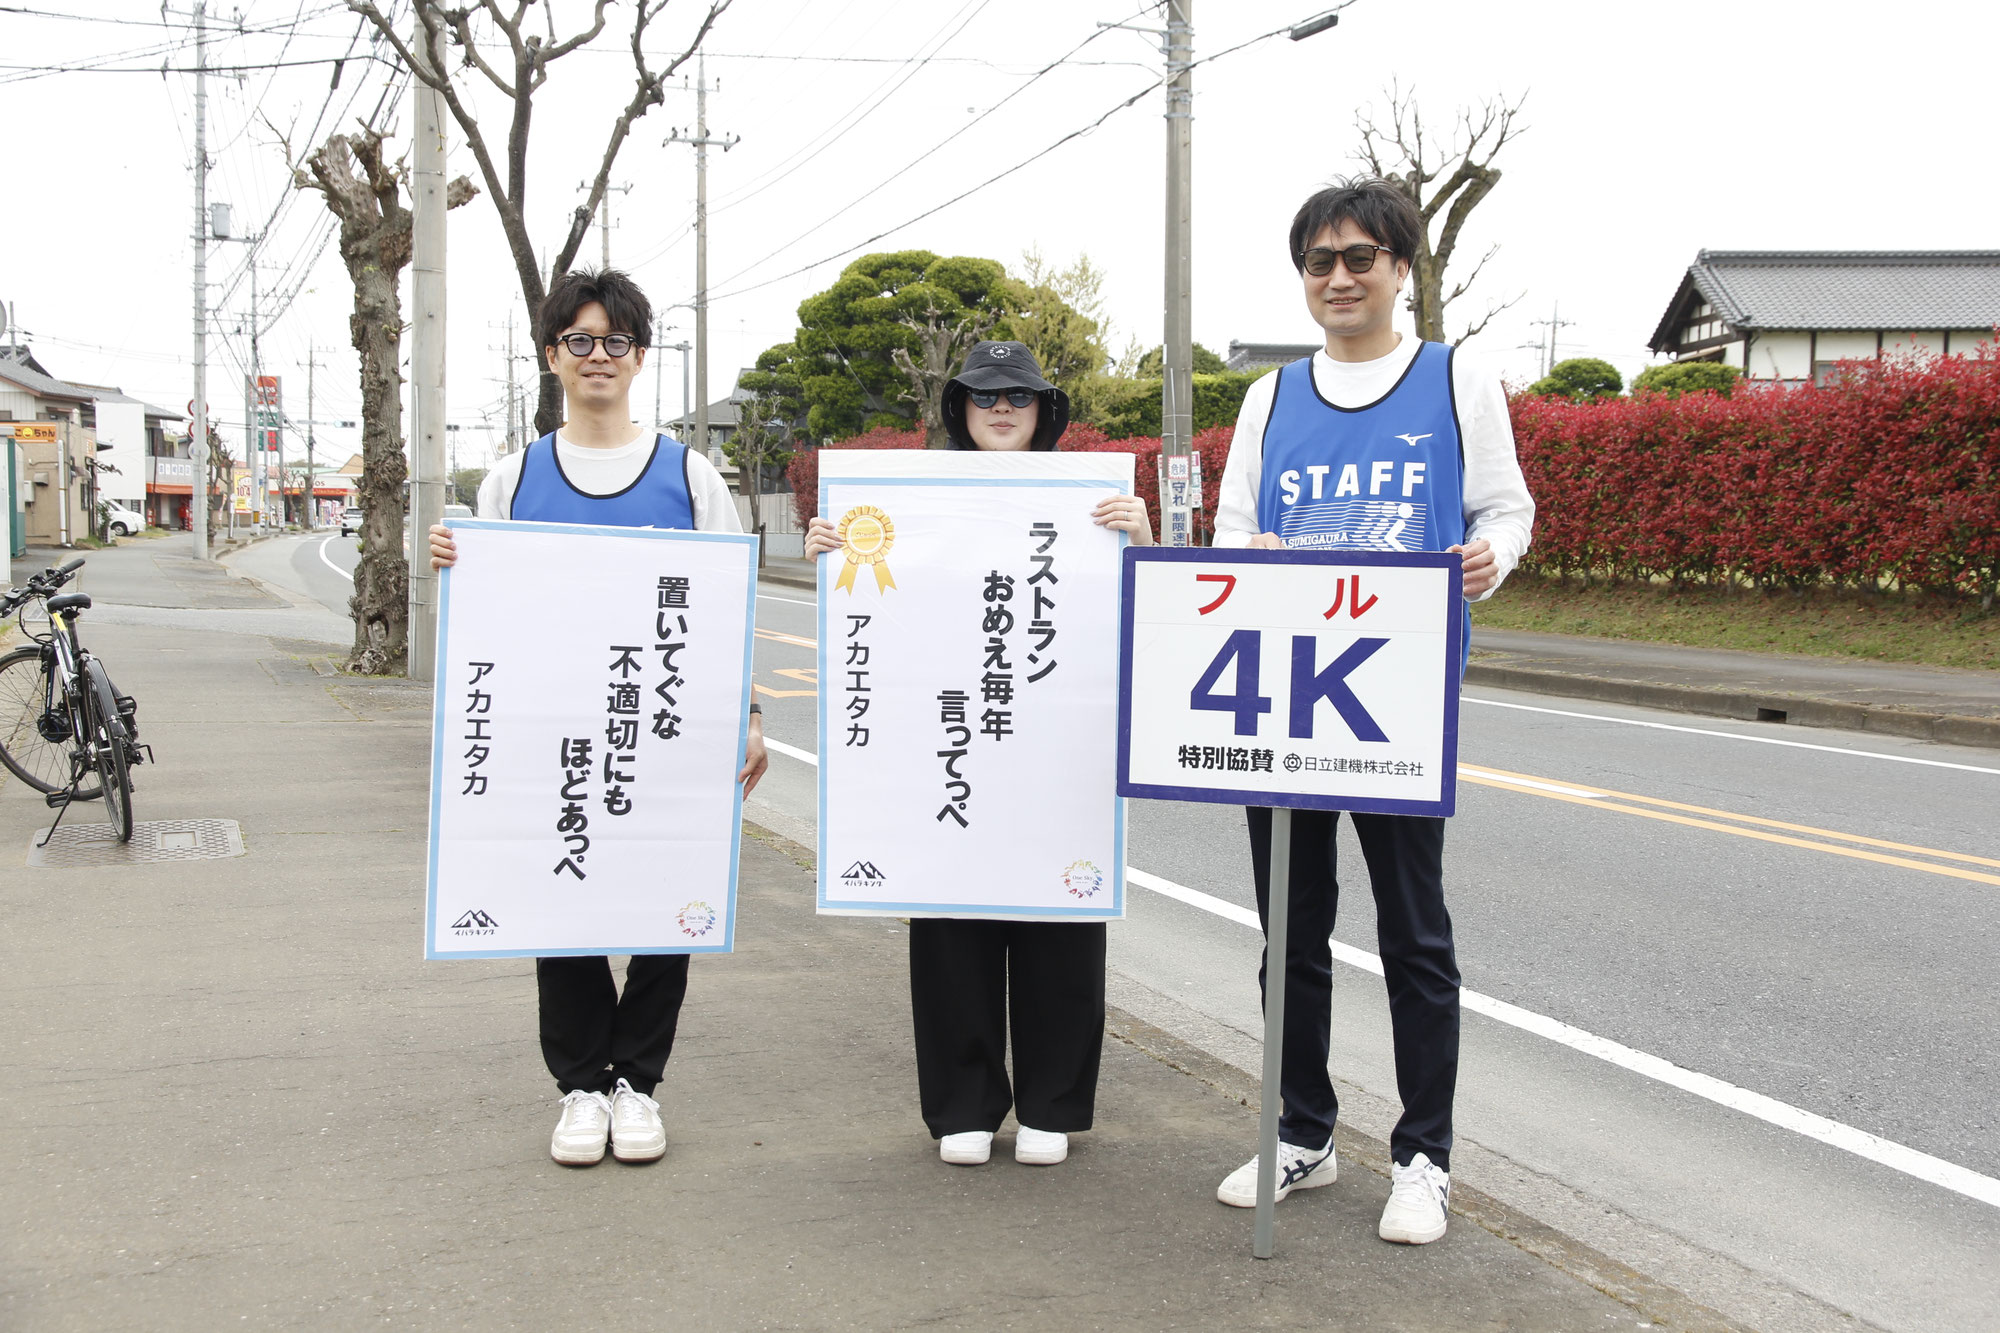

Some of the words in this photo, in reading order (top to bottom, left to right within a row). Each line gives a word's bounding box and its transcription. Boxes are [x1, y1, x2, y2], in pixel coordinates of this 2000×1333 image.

[1172, 482, 1186, 506] 守れ
[1280, 461, 1427, 506] STAFF
[1280, 532, 1349, 548] ASUMIGAURA
[651, 576, 690, 740] 置いてぐな
[980, 569, 1016, 742] おめえ毎年
[1026, 522, 1059, 684] ラストラン
[462, 661, 495, 796] アカエタカ
[603, 645, 643, 816] 不適切にも
[845, 615, 872, 747] アカエタカ
[1190, 629, 1391, 743] 4K
[553, 737, 593, 881] ほどあっぺ
[936, 690, 972, 829] 言ってっぺ
[1178, 744, 1274, 773] 特別協賛
[1304, 756, 1424, 777] 日立建機株式会社
